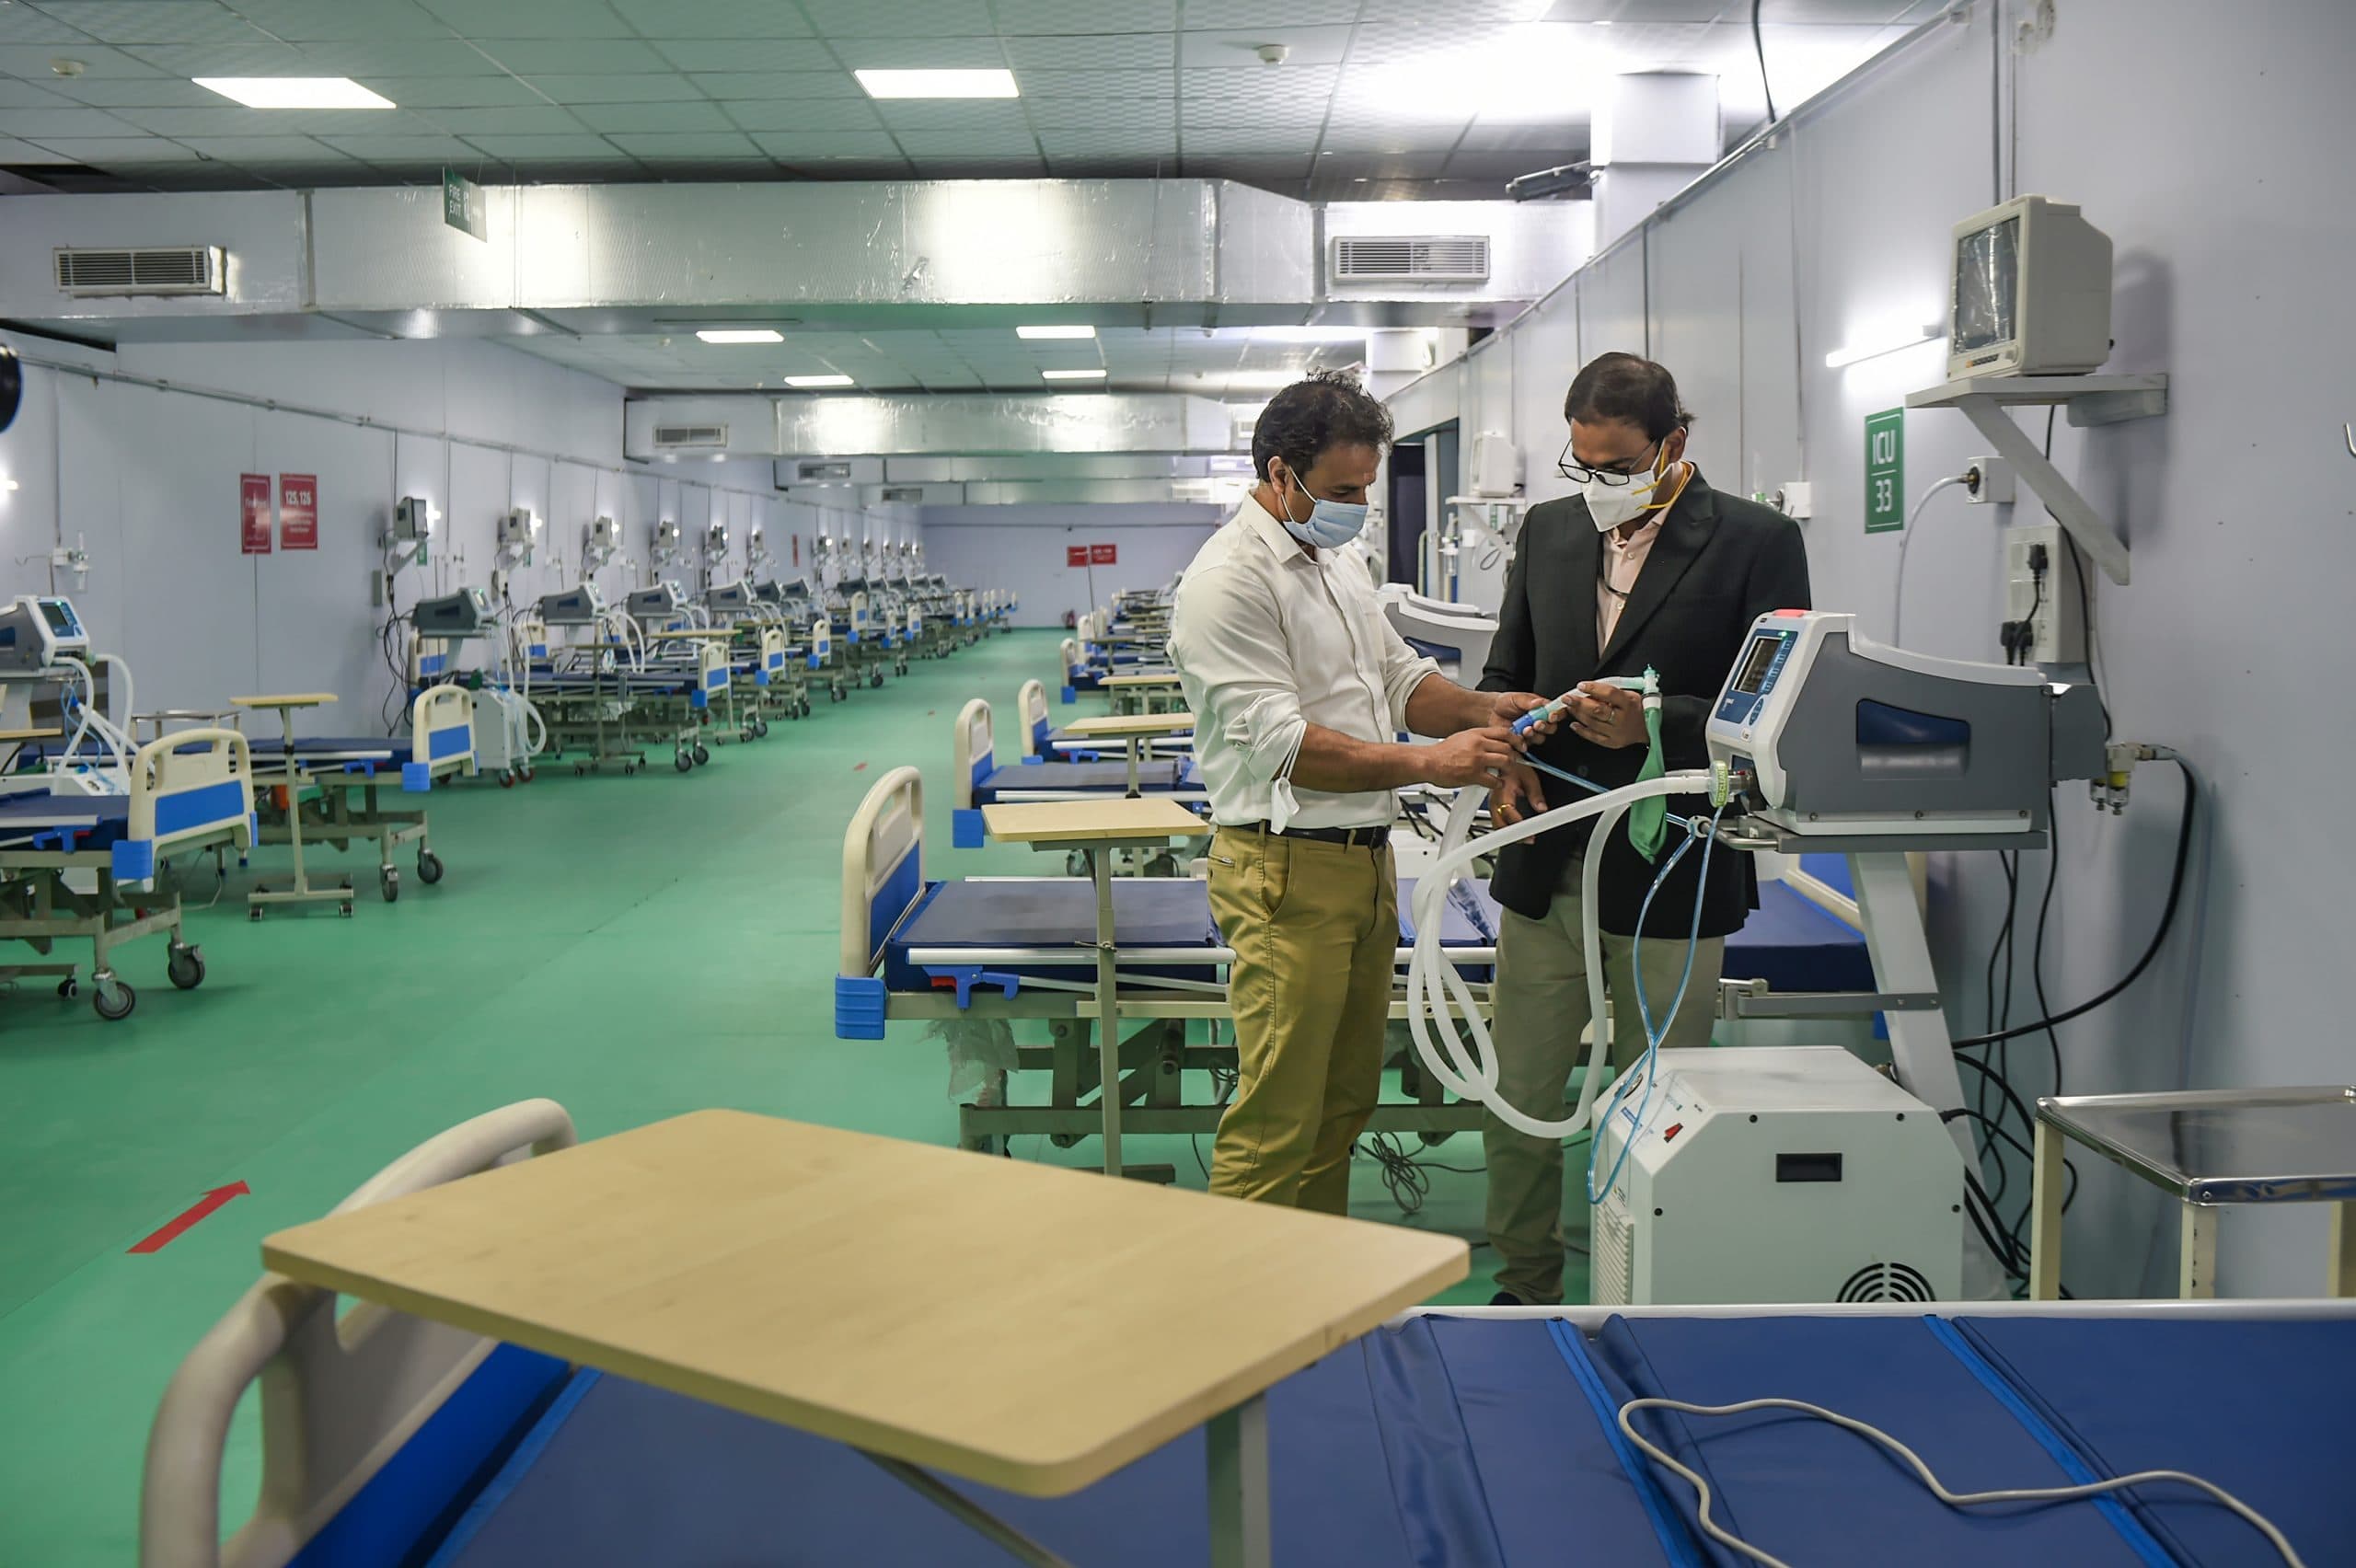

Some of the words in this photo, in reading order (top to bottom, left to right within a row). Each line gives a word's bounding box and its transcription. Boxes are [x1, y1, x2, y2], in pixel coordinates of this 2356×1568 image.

[449, 183, 460, 202] FIRE
[450, 200, 461, 217] EXIT
[1872, 429, 1896, 466] ICU
[1876, 478, 1892, 513] 33
